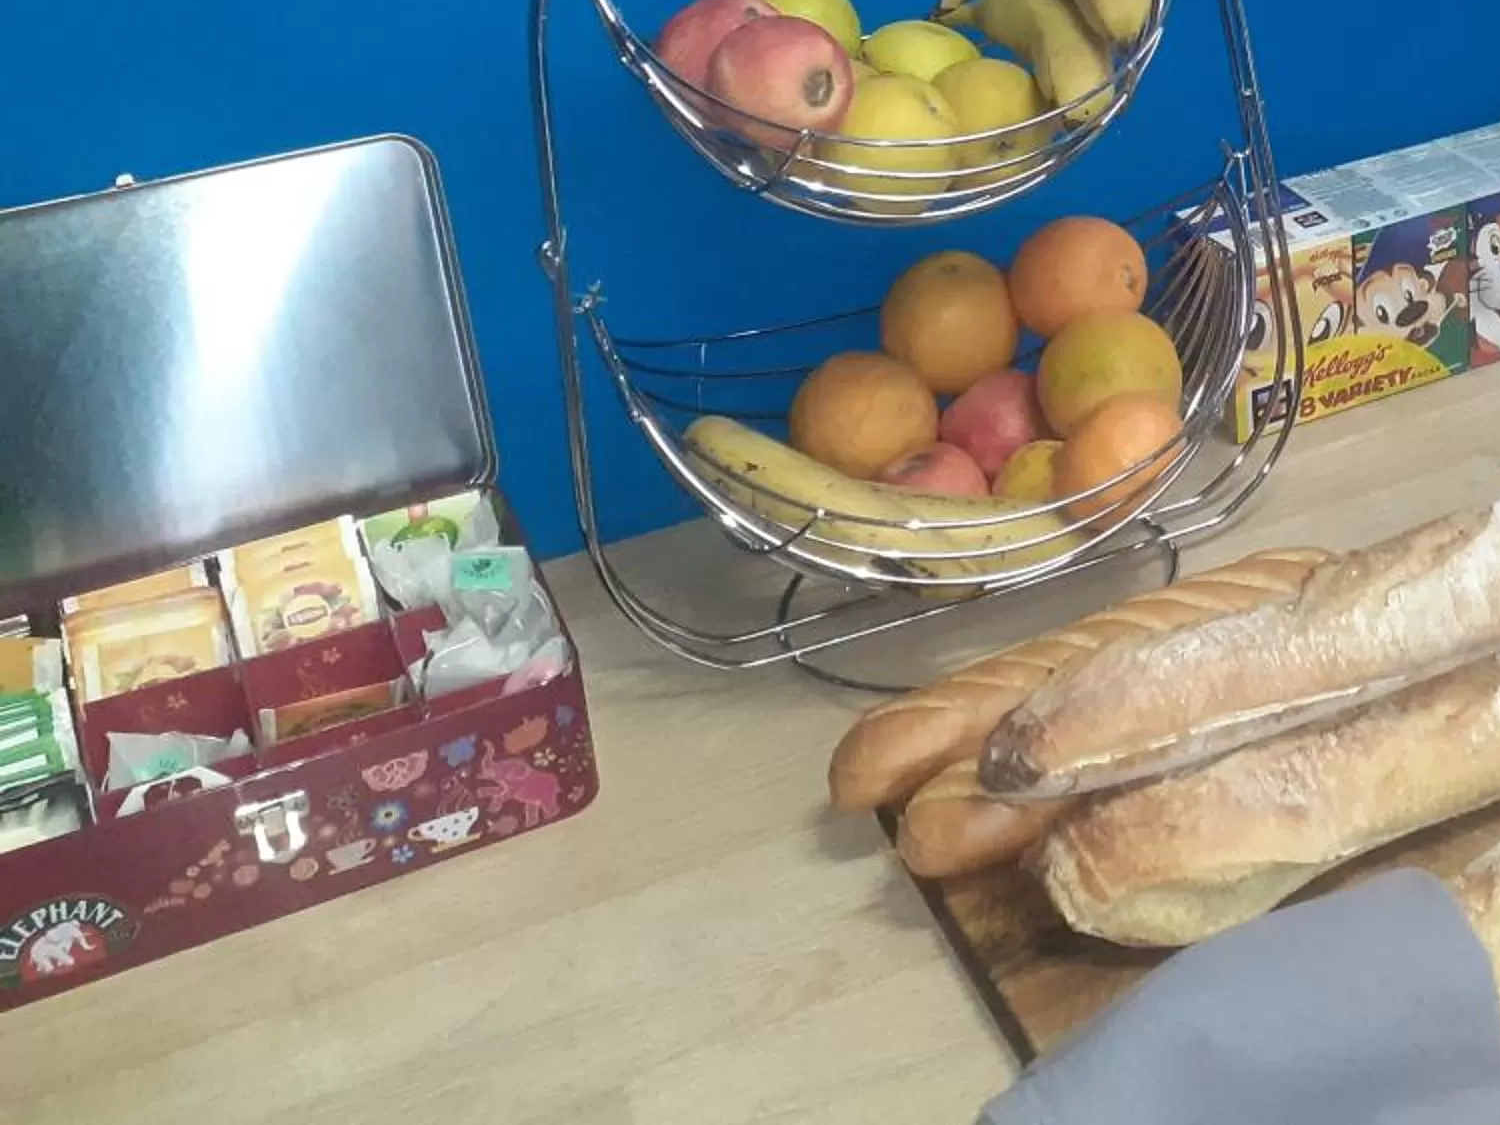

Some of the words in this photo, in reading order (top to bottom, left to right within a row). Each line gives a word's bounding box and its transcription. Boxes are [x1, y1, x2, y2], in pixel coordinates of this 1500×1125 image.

[1303, 343, 1388, 388] Kellogg's
[1300, 397, 1316, 418] 8
[1319, 366, 1413, 409] VARIETY
[0, 900, 124, 961] ELEPHANT
